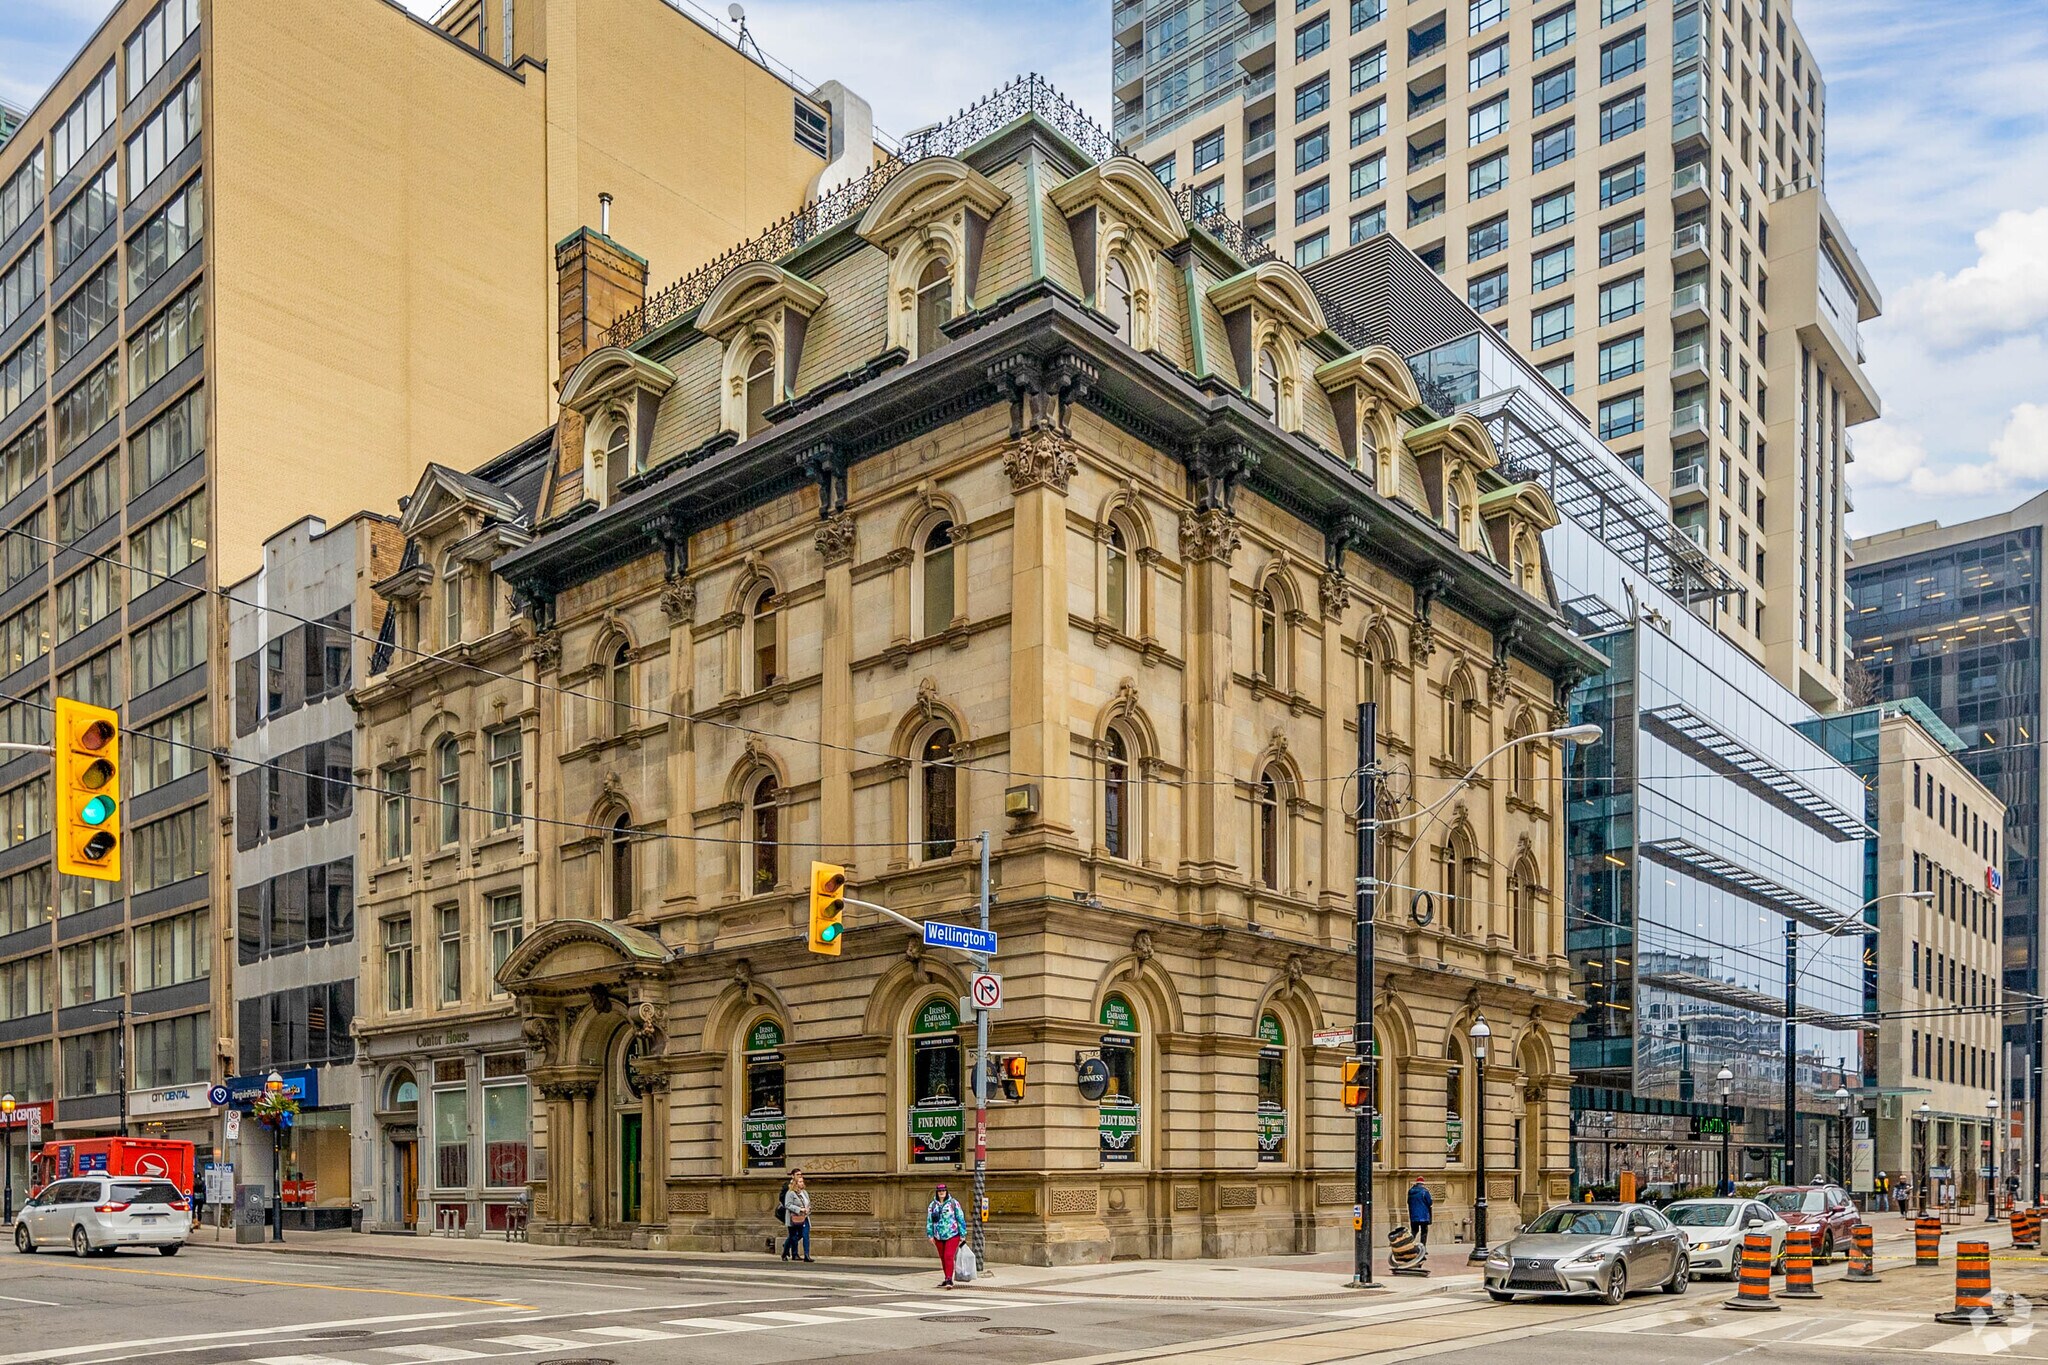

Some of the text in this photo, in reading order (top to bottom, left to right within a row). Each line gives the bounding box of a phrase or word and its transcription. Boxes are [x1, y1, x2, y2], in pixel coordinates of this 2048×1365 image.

[928, 923, 986, 947] Wellington
[929, 1006, 946, 1015] IRISH
[1110, 1003, 1125, 1013] IRISH
[924, 1012, 952, 1022] EMBASSY
[1106, 1010, 1129, 1021] EMBASSY
[759, 1026, 773, 1034] IRISH
[445, 1030, 470, 1044] House
[755, 1032, 777, 1040] EMBASSY
[1079, 1074, 1104, 1083] GUINNESS
[918, 1115, 957, 1128] FINE FOODS
[1118, 1115, 1136, 1126] BEERS
[1854, 1119, 1867, 1132] 20
[746, 1123, 761, 1132] IRISH
